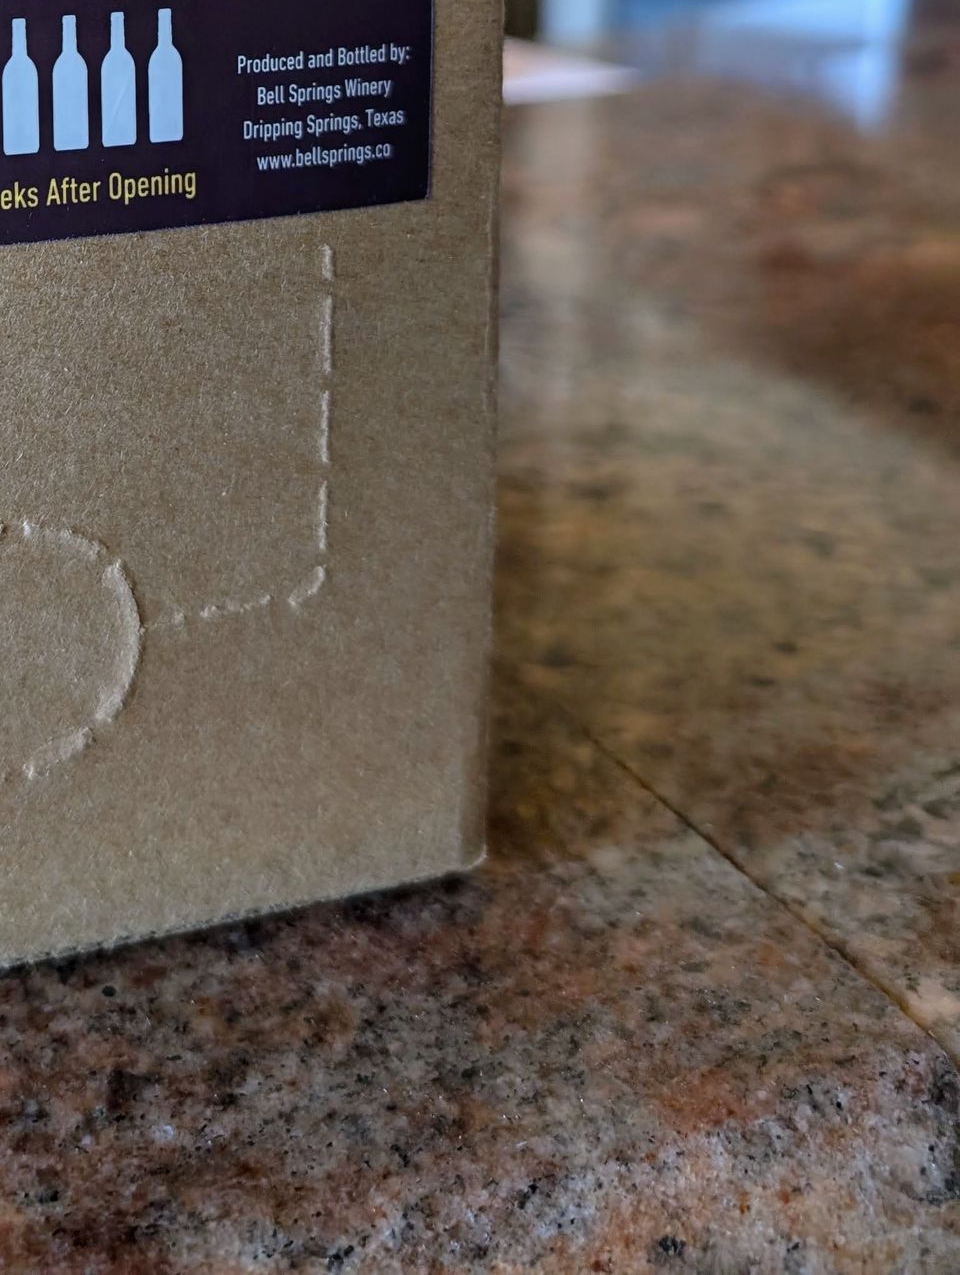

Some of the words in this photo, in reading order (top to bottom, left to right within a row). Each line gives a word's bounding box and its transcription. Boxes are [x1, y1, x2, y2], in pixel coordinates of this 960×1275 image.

[238, 51, 303, 74] Produced
[308, 49, 333, 68] and
[338, 44, 385, 65] Bottled
[390, 43, 409, 64] by:
[258, 85, 284, 105] Bell
[289, 83, 341, 106] Springs
[345, 78, 391, 97] Winery
[244, 118, 302, 141] Dripping
[307, 113, 361, 136] Springs,
[365, 109, 404, 126] Texas
[257, 144, 390, 170] www.bellsprings.co
[47, 177, 101, 205] After
[109, 168, 195, 205] Opening
